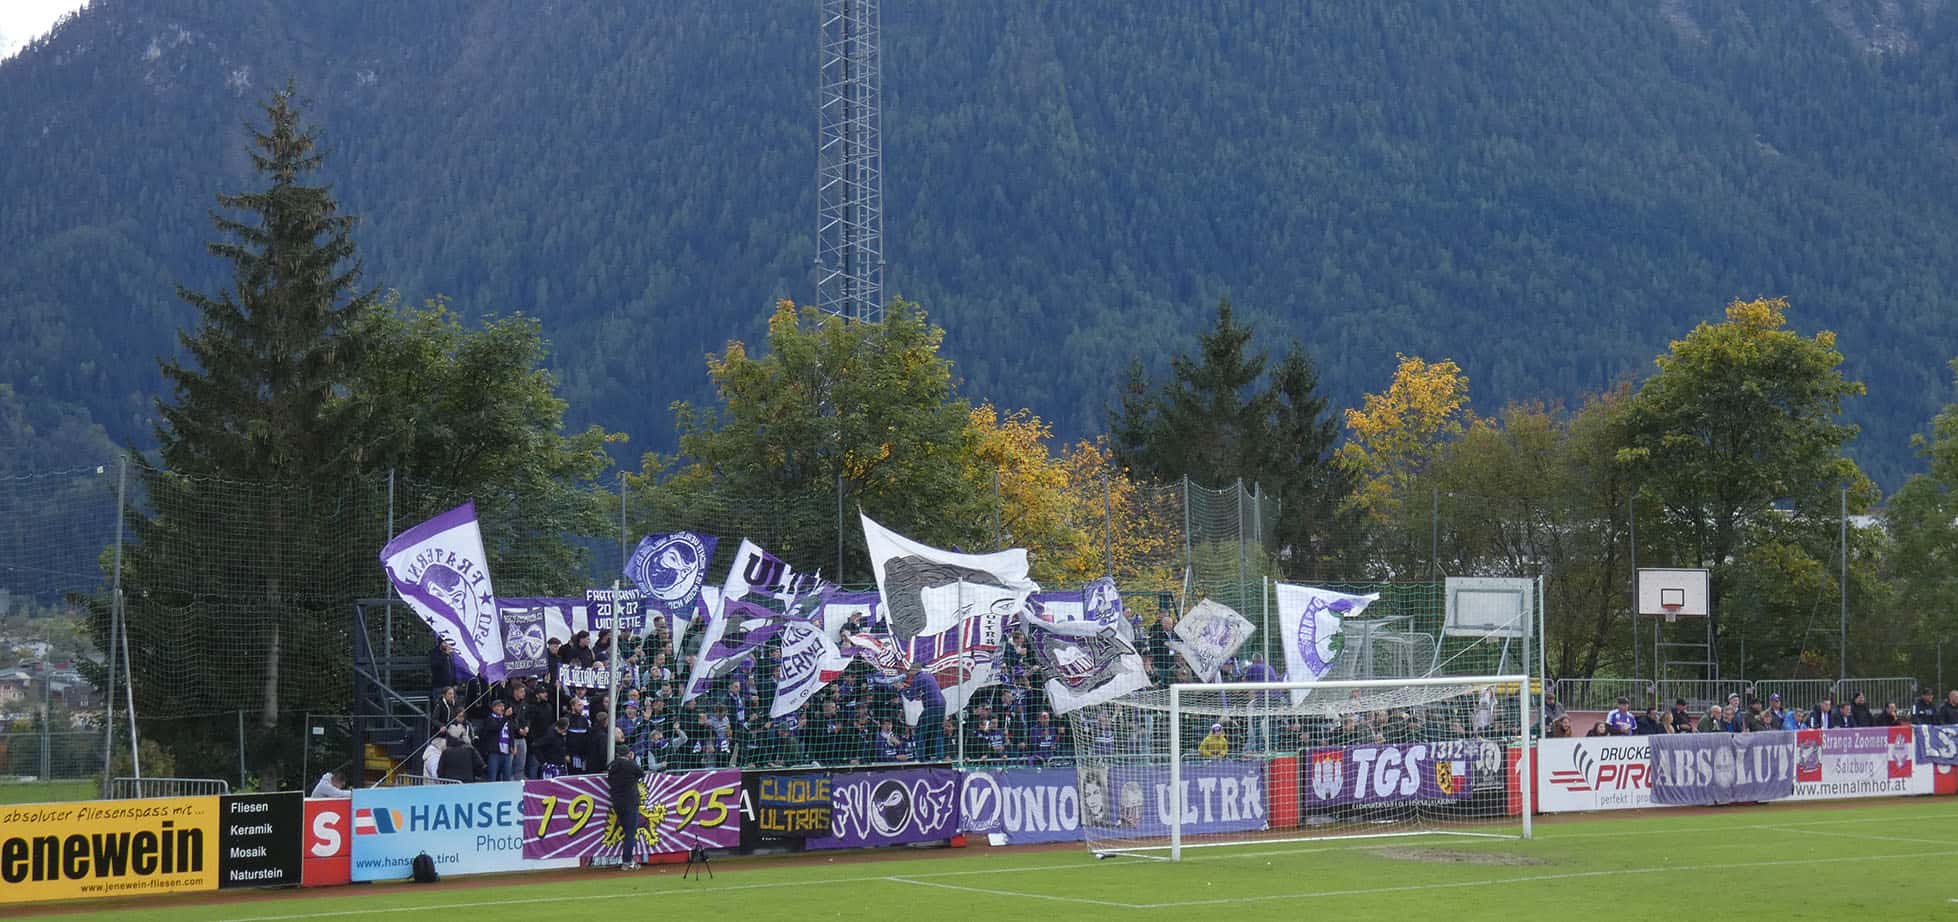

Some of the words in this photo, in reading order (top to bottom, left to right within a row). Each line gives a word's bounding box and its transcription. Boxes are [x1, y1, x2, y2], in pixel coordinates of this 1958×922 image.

[1352, 745, 1426, 799] TGS
[1836, 759, 1874, 776] Salzburg
[761, 779, 831, 803] CLIQUE
[231, 802, 268, 813] Fliesen
[4, 808, 72, 823] absoluter
[760, 808, 831, 832] ULTRAS
[230, 823, 272, 836] Keramik
[477, 835, 523, 851] Photo
[230, 846, 267, 859] Mosaik
[230, 868, 283, 881] Naturstein
[81, 878, 203, 893] www.jenewein-fliesen.com
